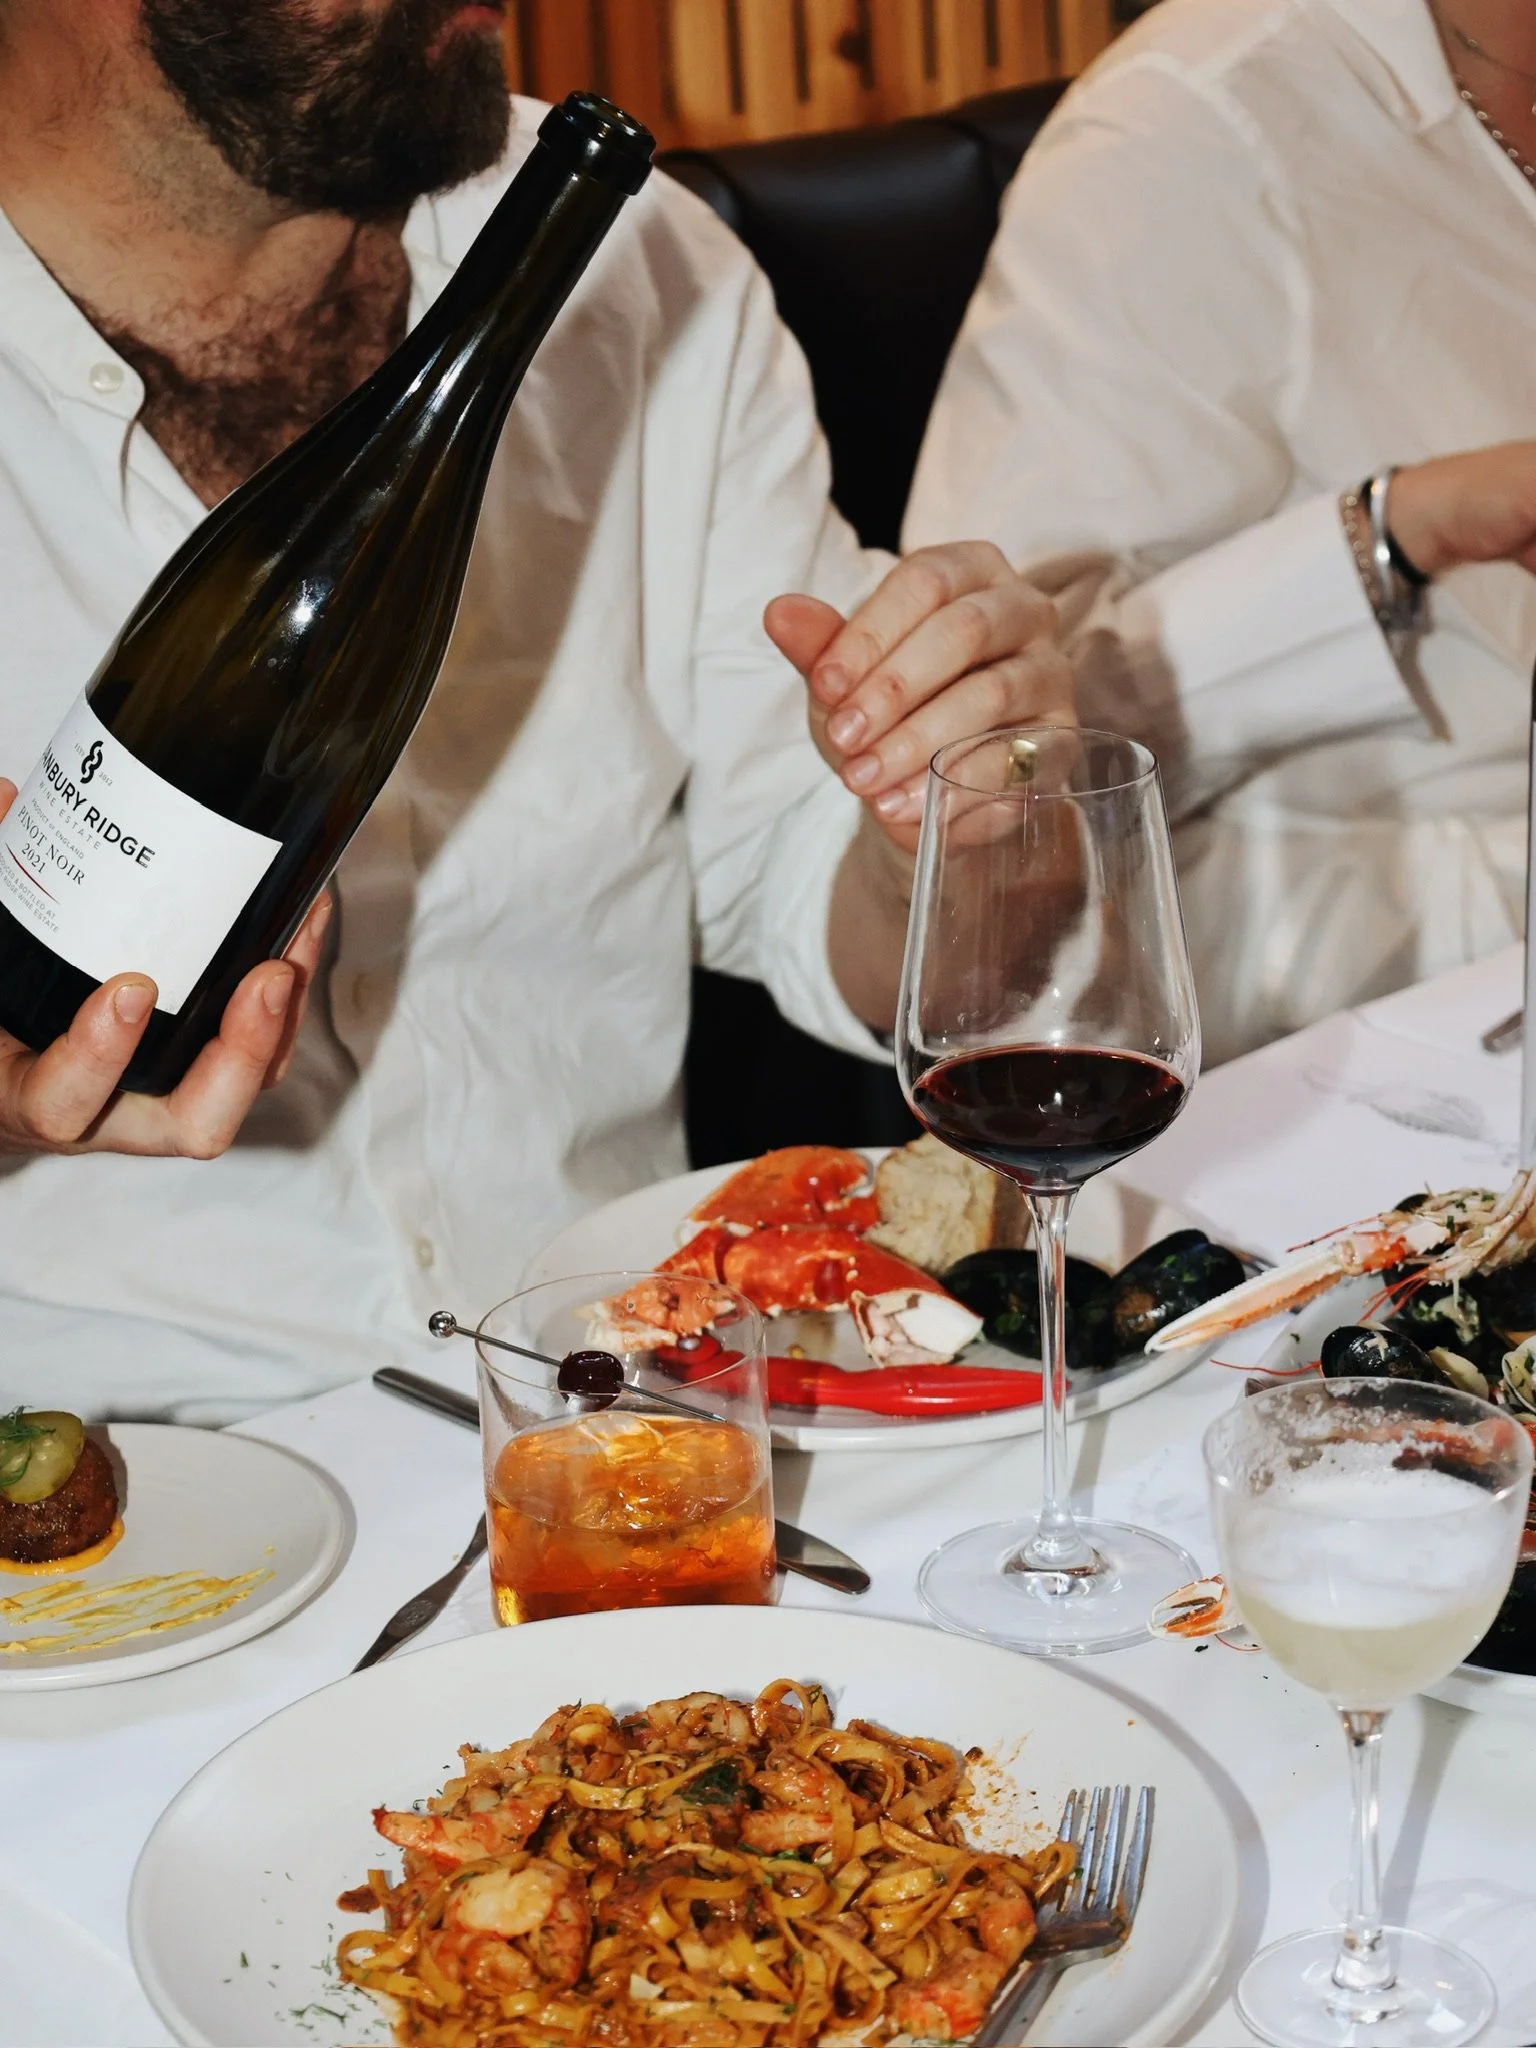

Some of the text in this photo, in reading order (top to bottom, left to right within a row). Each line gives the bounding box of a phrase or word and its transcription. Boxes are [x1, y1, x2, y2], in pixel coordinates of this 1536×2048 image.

[98, 770, 113, 787] 2012
[32, 797, 49, 825] PRODUCT
[55, 830, 85, 859] ENGLAND
[39, 780, 102, 850] WINE ESTATE
[83, 805, 156, 869] RIDGE
[17, 805, 85, 885] PINOT NOIR
[21, 842, 46, 874] 2021
[18, 882, 46, 911] BOTTLED
[46, 909, 56, 920] AT
[18, 894, 34, 912] WINE
[33, 908, 60, 933] ESTATE
